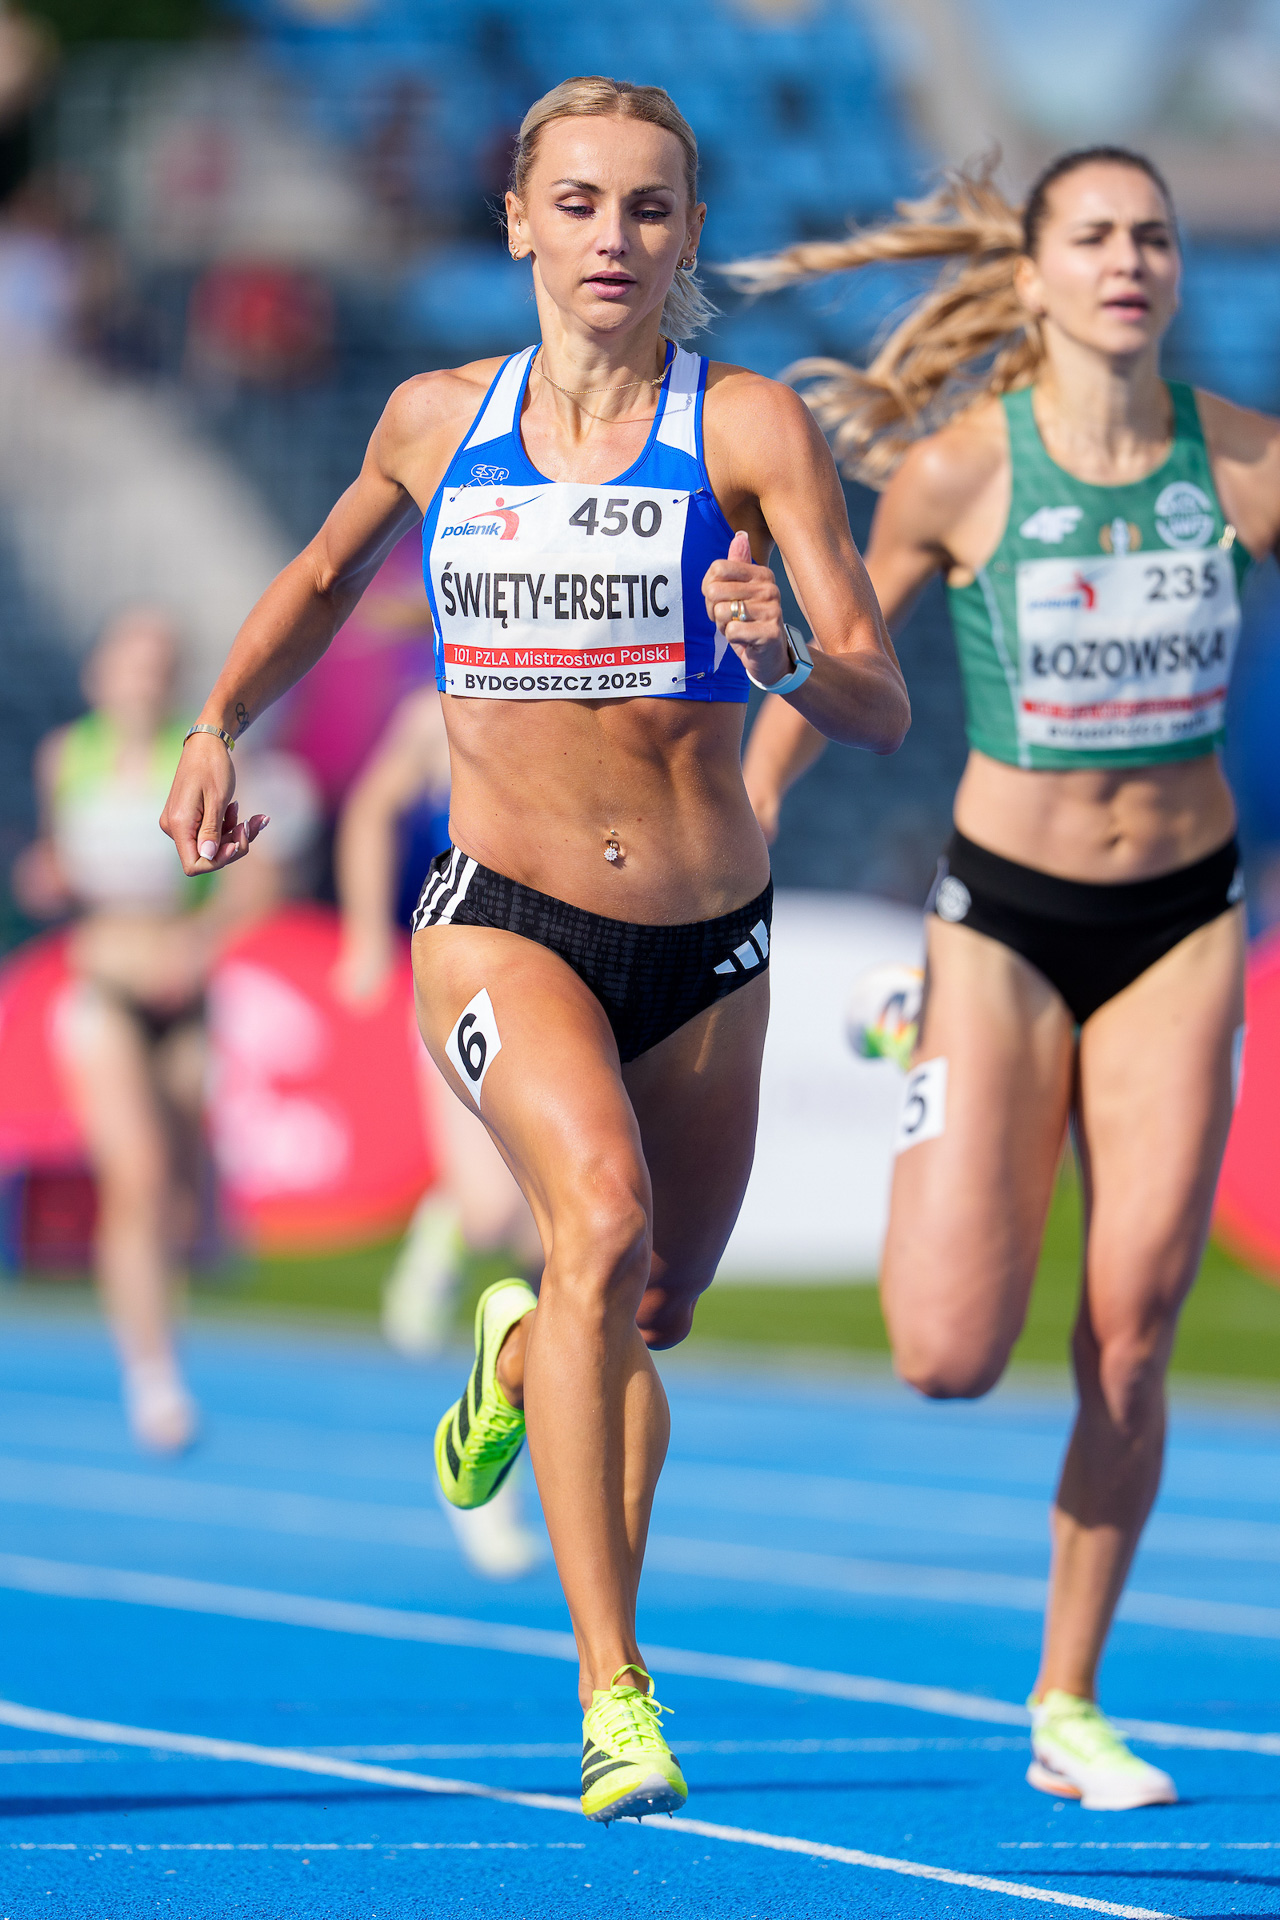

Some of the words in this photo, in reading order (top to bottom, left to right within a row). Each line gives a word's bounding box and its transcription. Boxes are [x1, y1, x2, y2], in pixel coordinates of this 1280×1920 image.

[440, 522, 502, 539] polanik
[568, 497, 662, 538] 450
[440, 561, 670, 629] ŚWIĘTY-ERSETIC
[1146, 559, 1220, 602] 235
[453, 648, 473, 663] 101.
[475, 649, 511, 666] PZLA
[514, 650, 615, 666] Mistrzostwa
[621, 646, 670, 662] Polski
[1031, 629, 1226, 680] ŁOZOWSKA
[464, 674, 593, 692] BYDGOSZCZ
[598, 671, 652, 690] 2025
[457, 1012, 487, 1082] 6
[904, 1071, 928, 1136] 5
